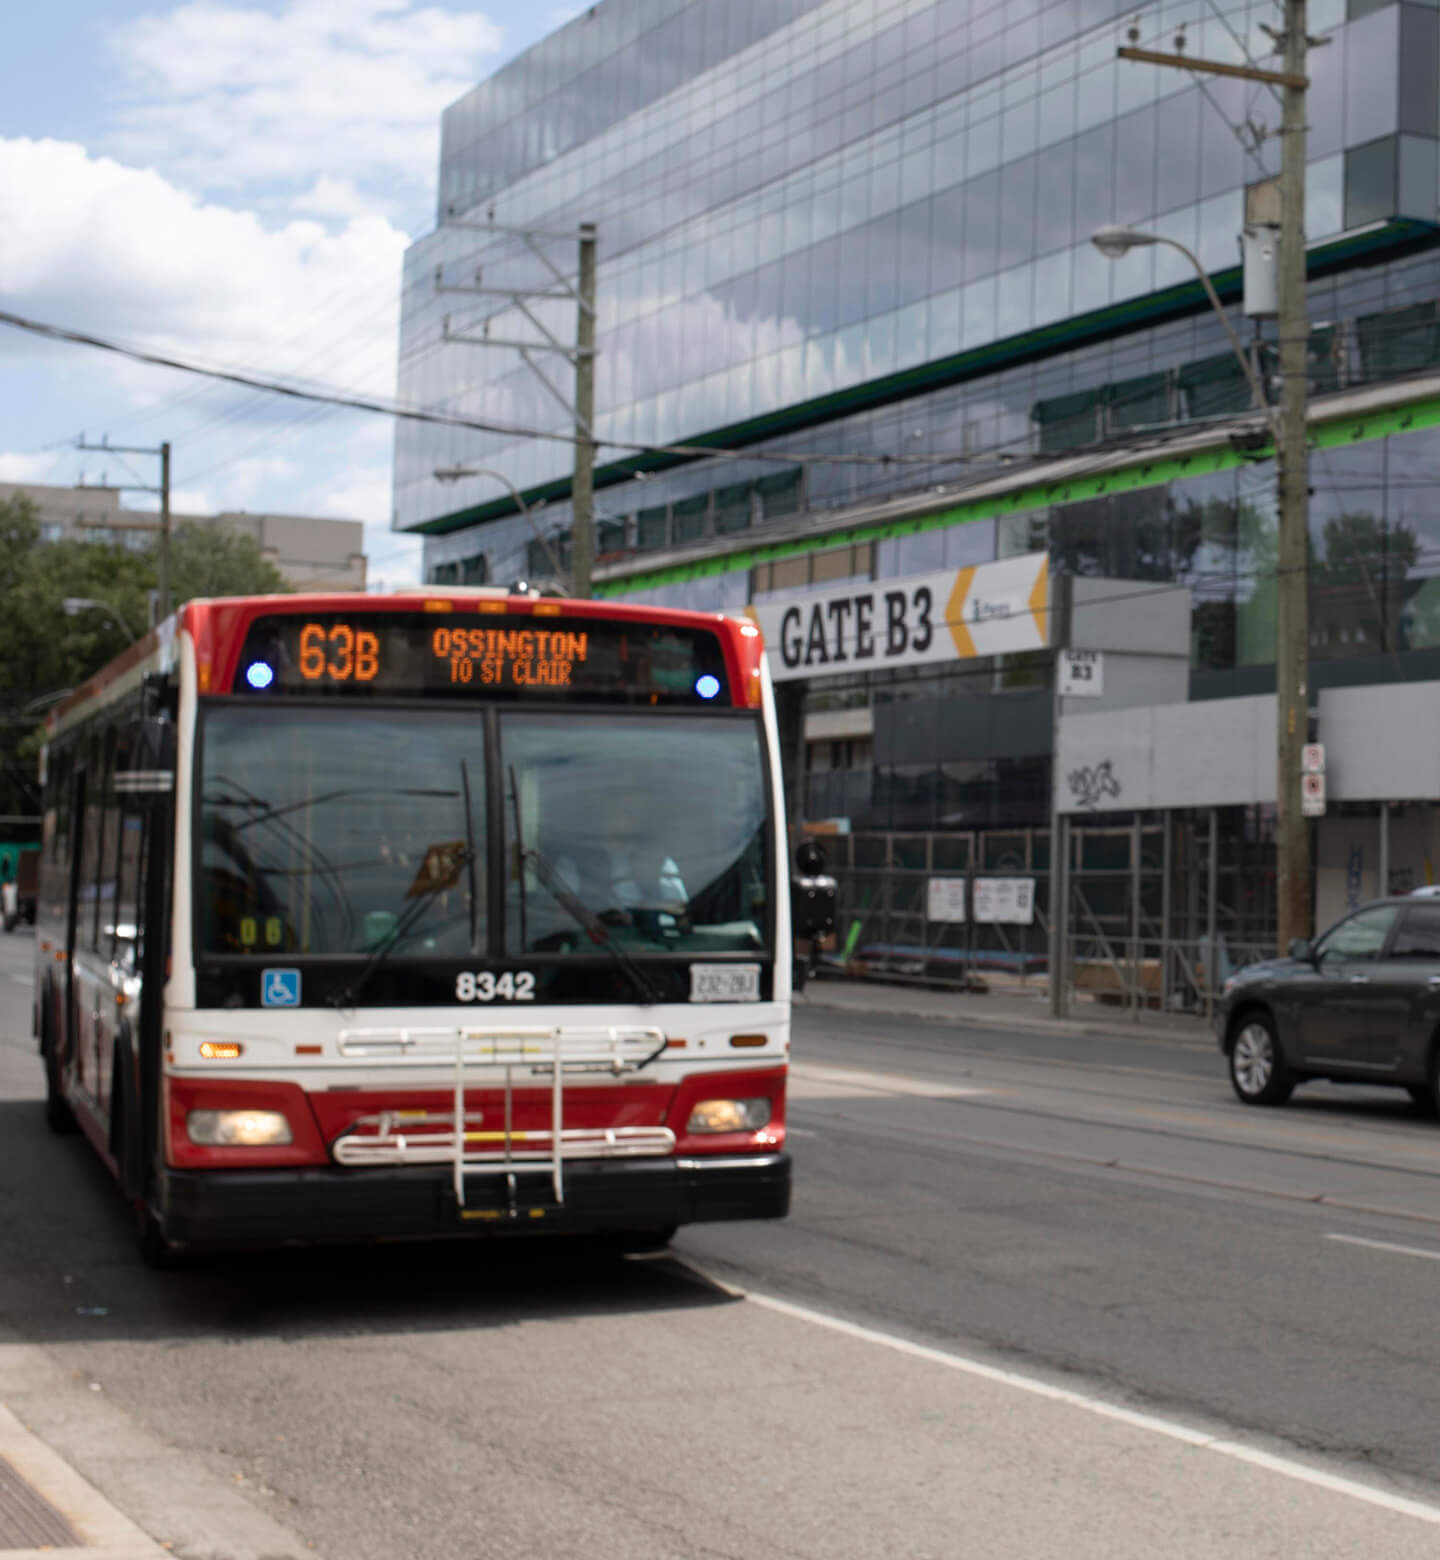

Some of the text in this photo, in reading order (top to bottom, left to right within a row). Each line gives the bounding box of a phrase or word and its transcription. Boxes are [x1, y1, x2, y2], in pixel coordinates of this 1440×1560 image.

[781, 586, 933, 669] GATE B3
[299, 623, 380, 682] 63B
[432, 628, 588, 661] OSSINGTON
[450, 656, 573, 686] TO ST CLAIR
[456, 972, 536, 1001] 8342
